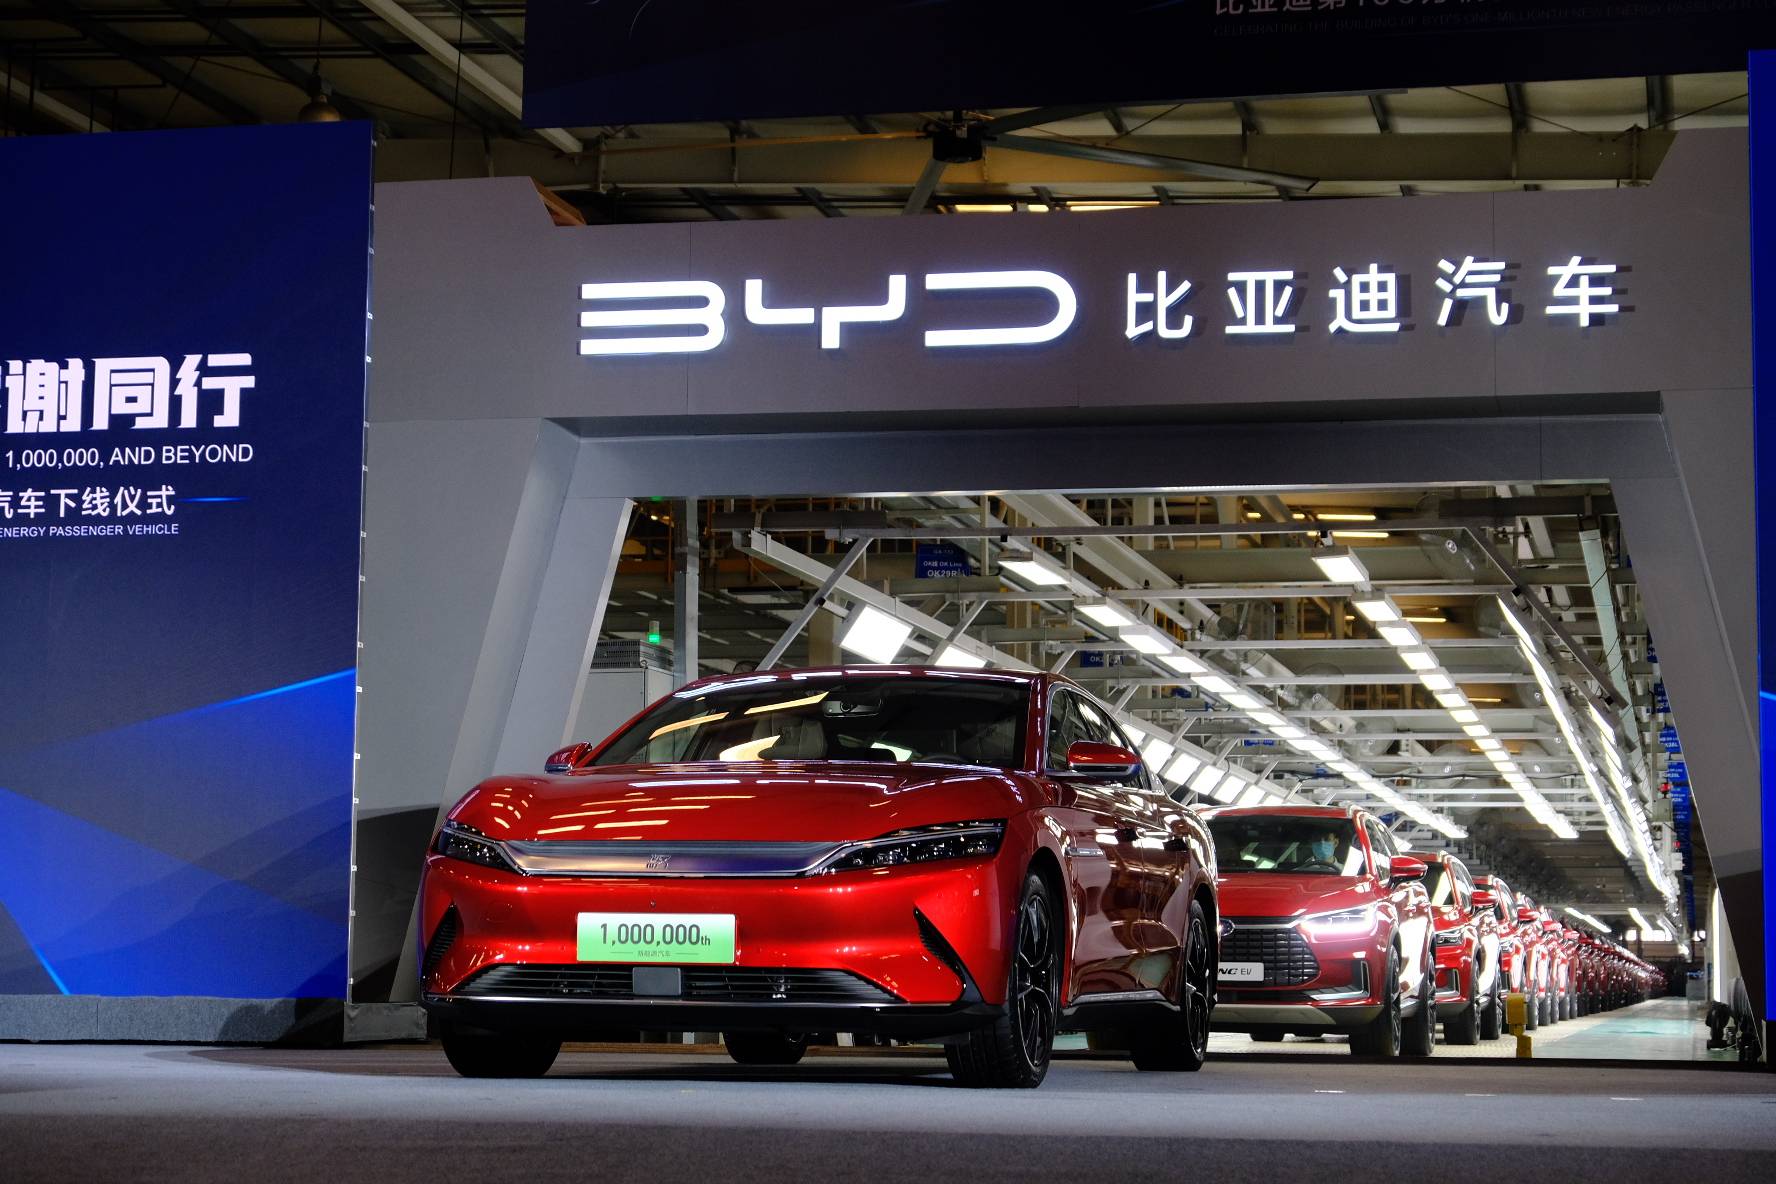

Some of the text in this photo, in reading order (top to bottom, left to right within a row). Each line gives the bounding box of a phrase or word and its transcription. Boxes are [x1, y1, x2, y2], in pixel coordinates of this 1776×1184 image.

[579, 255, 1620, 356] BYD 比亚迪汽车
[0, 353, 256, 434] 谢同行
[5, 443, 253, 470] 1,000,000, AND BEYOND
[49, 525, 123, 537] PASSENGER
[127, 523, 179, 535] VEHICLE
[600, 922, 711, 947] 1,000,000th
